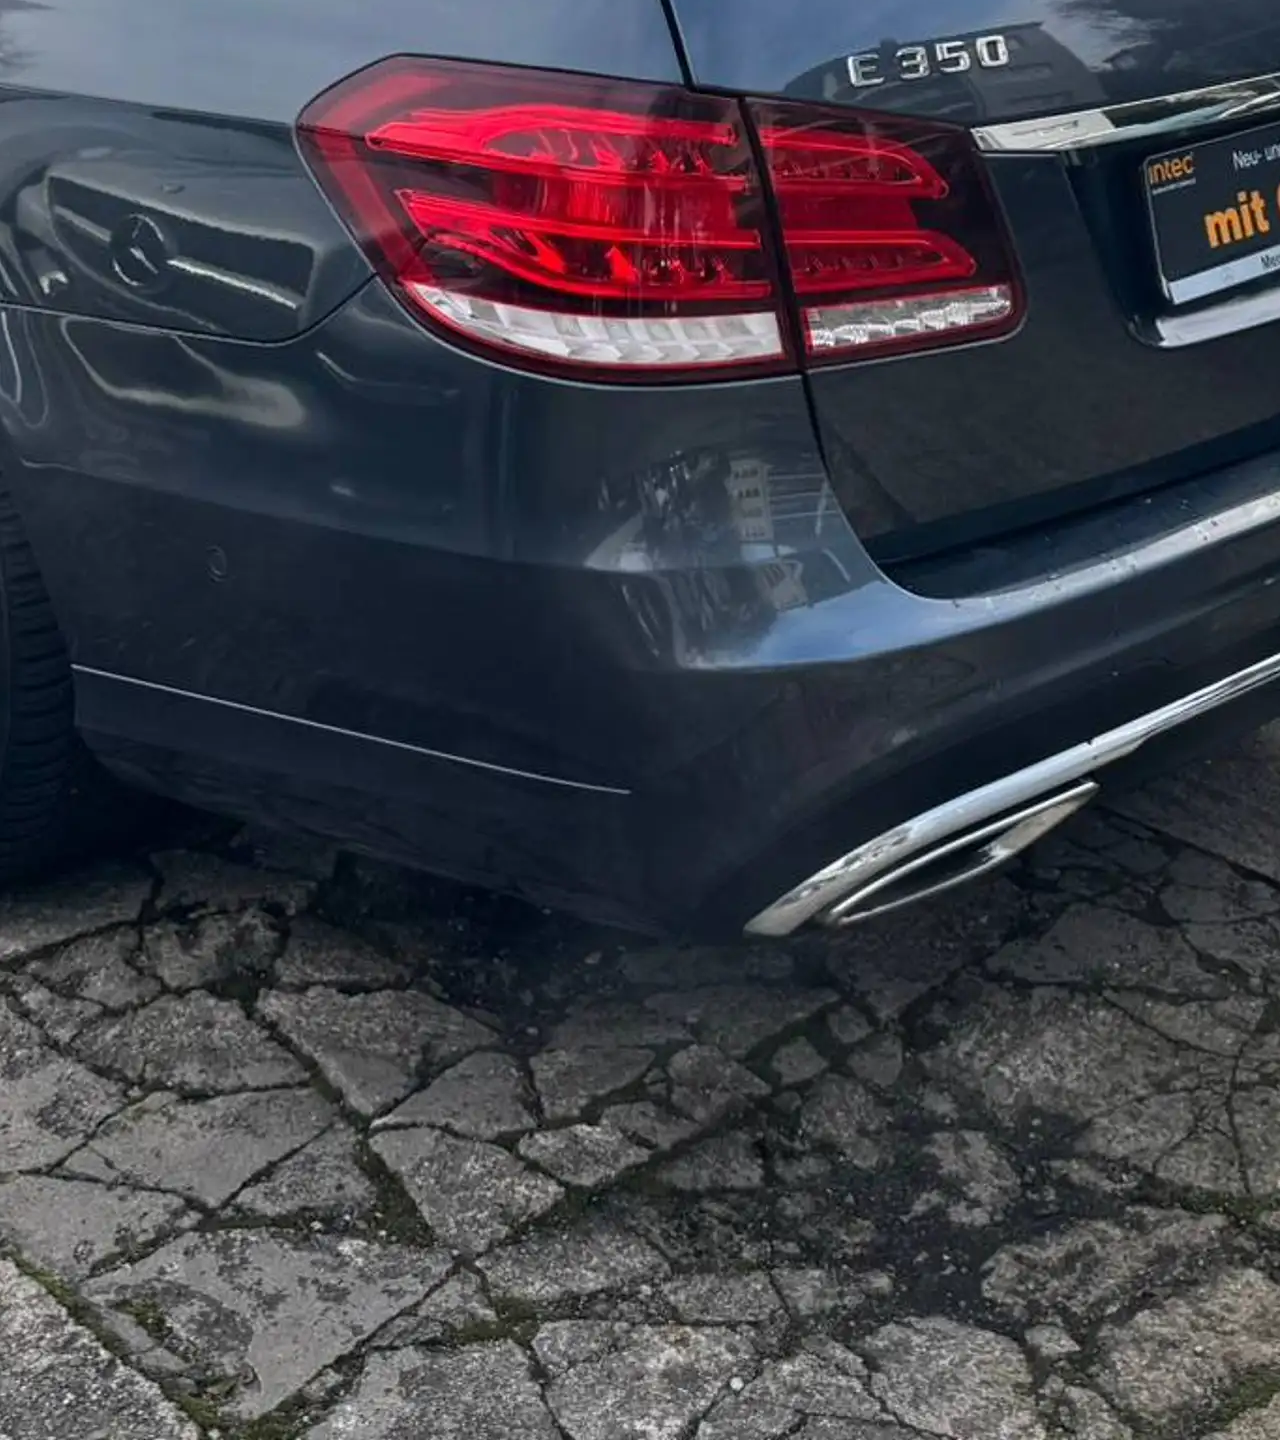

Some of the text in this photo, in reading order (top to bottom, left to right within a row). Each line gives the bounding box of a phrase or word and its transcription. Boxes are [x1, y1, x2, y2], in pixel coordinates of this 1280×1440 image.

[847, 34, 1010, 88] E 350
[1148, 153, 1195, 185] intec
[1232, 147, 1263, 171] Neu-
[1204, 190, 1269, 248] mit
